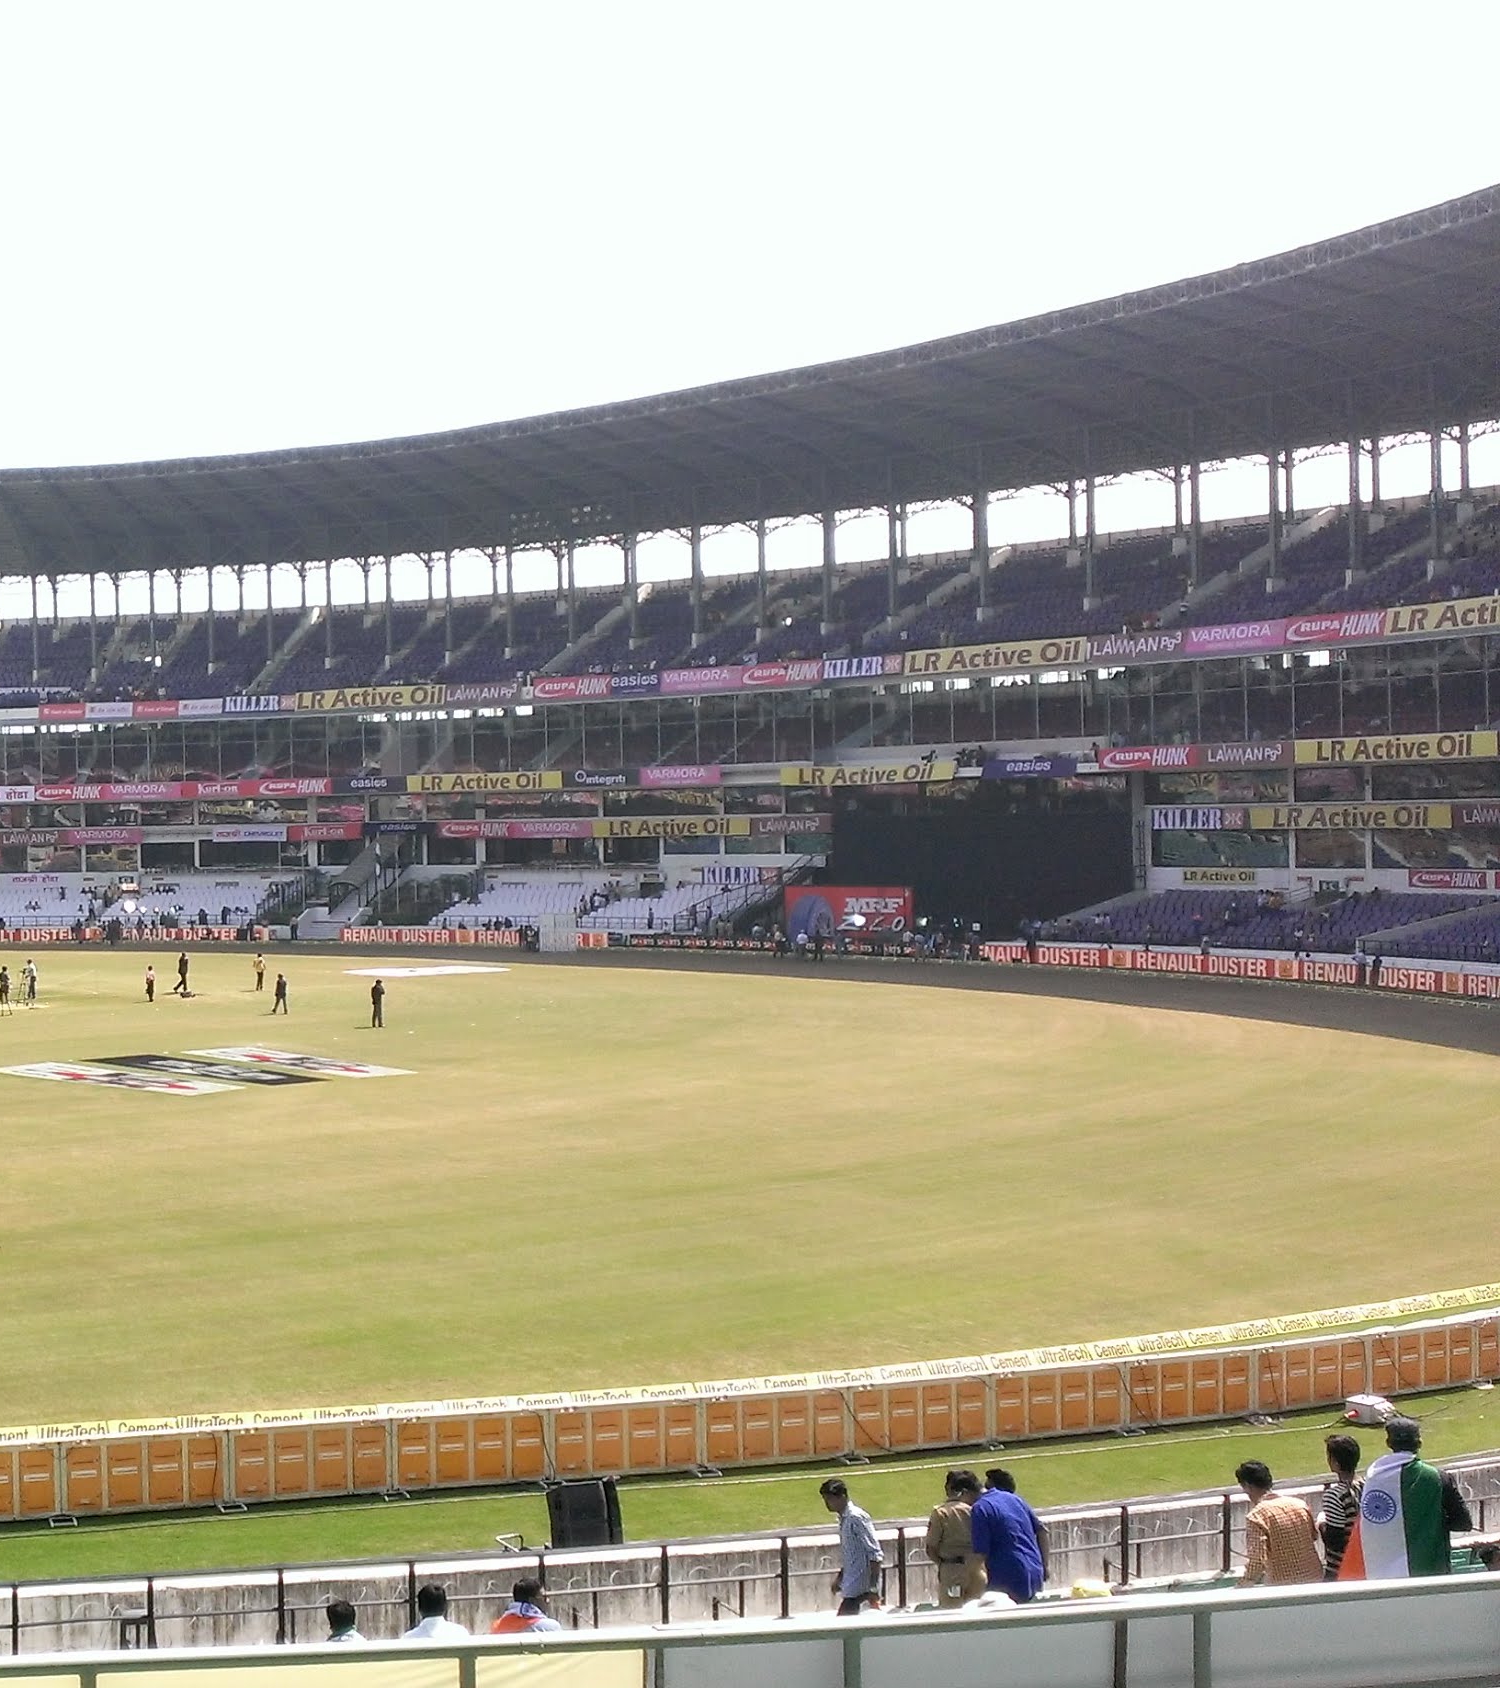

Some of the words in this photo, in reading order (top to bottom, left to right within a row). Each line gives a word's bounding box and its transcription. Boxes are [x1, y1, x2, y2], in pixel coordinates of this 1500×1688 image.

[1300, 620, 1340, 632] RUPA
[1340, 612, 1385, 636] HUNK
[1390, 607, 1428, 633] LR
[1191, 624, 1271, 642] VARMORA
[909, 652, 940, 673] LR
[948, 648, 1031, 670] Active
[1040, 641, 1081, 662] Oil
[663, 669, 729, 683] VARMORA
[753, 667, 786, 678] RUPA
[786, 661, 821, 681] HUNK
[823, 656, 883, 679] KILLER
[544, 682, 576, 691] RUPA
[576, 677, 610, 696] HUNK
[225, 694, 280, 713] KILLER
[296, 693, 325, 710] LR
[332, 690, 402, 708] Active
[410, 685, 446, 704] Oil
[1115, 752, 1151, 761] RUPA
[1151, 747, 1189, 766] HUNK
[1316, 741, 1345, 761] LR
[1352, 738, 1430, 759] Active
[1436, 735, 1472, 756] Oil
[421, 776, 443, 791] LR
[451, 774, 511, 790] Active
[515, 773, 542, 788] Oil
[647, 768, 706, 778] VARMORA
[799, 768, 824, 784] LR
[831, 766, 898, 783] Active
[903, 764, 934, 780] Oil
[72, 785, 102, 799] HUNK
[111, 785, 166, 794] VARMORA
[297, 778, 328, 793] HUNK
[1152, 808, 1222, 830] KILLER
[1273, 807, 1301, 828] LR
[1309, 806, 1386, 828] Active
[1393, 805, 1429, 826] Oil
[74, 829, 129, 839] VARMORA
[521, 822, 578, 832] VARMORA
[609, 820, 632, 836] LR
[637, 819, 701, 835] Active
[706, 817, 730, 833] Oil
[1183, 871, 1198, 881] LR
[1200, 871, 1237, 881] Active
[1238, 870, 1256, 881] Oil
[844, 897, 904, 913] MRF
[344, 929, 399, 942] RENAULT
[401, 929, 449, 942] DUSTER
[1039, 948, 1100, 965] DUSTER
[1137, 953, 1204, 973] RENAULT
[1209, 957, 1268, 977] DUSTER
[1304, 963, 1372, 985] RENAUT
[1379, 969, 1436, 992] DUSTER
[1229, 1319, 1272, 1341] UltraTech
[1277, 1316, 1313, 1333] Cement
[1137, 1331, 1183, 1352] UltraTech
[1187, 1328, 1226, 1346] Cement
[1041, 1345, 1089, 1365] UltraTech
[1094, 1340, 1134, 1359] Cement
[880, 1367, 924, 1380] Cement
[930, 1360, 983, 1377] UltraTech
[990, 1354, 1032, 1370] Cement
[41, 1424, 107, 1440] UltraTech
